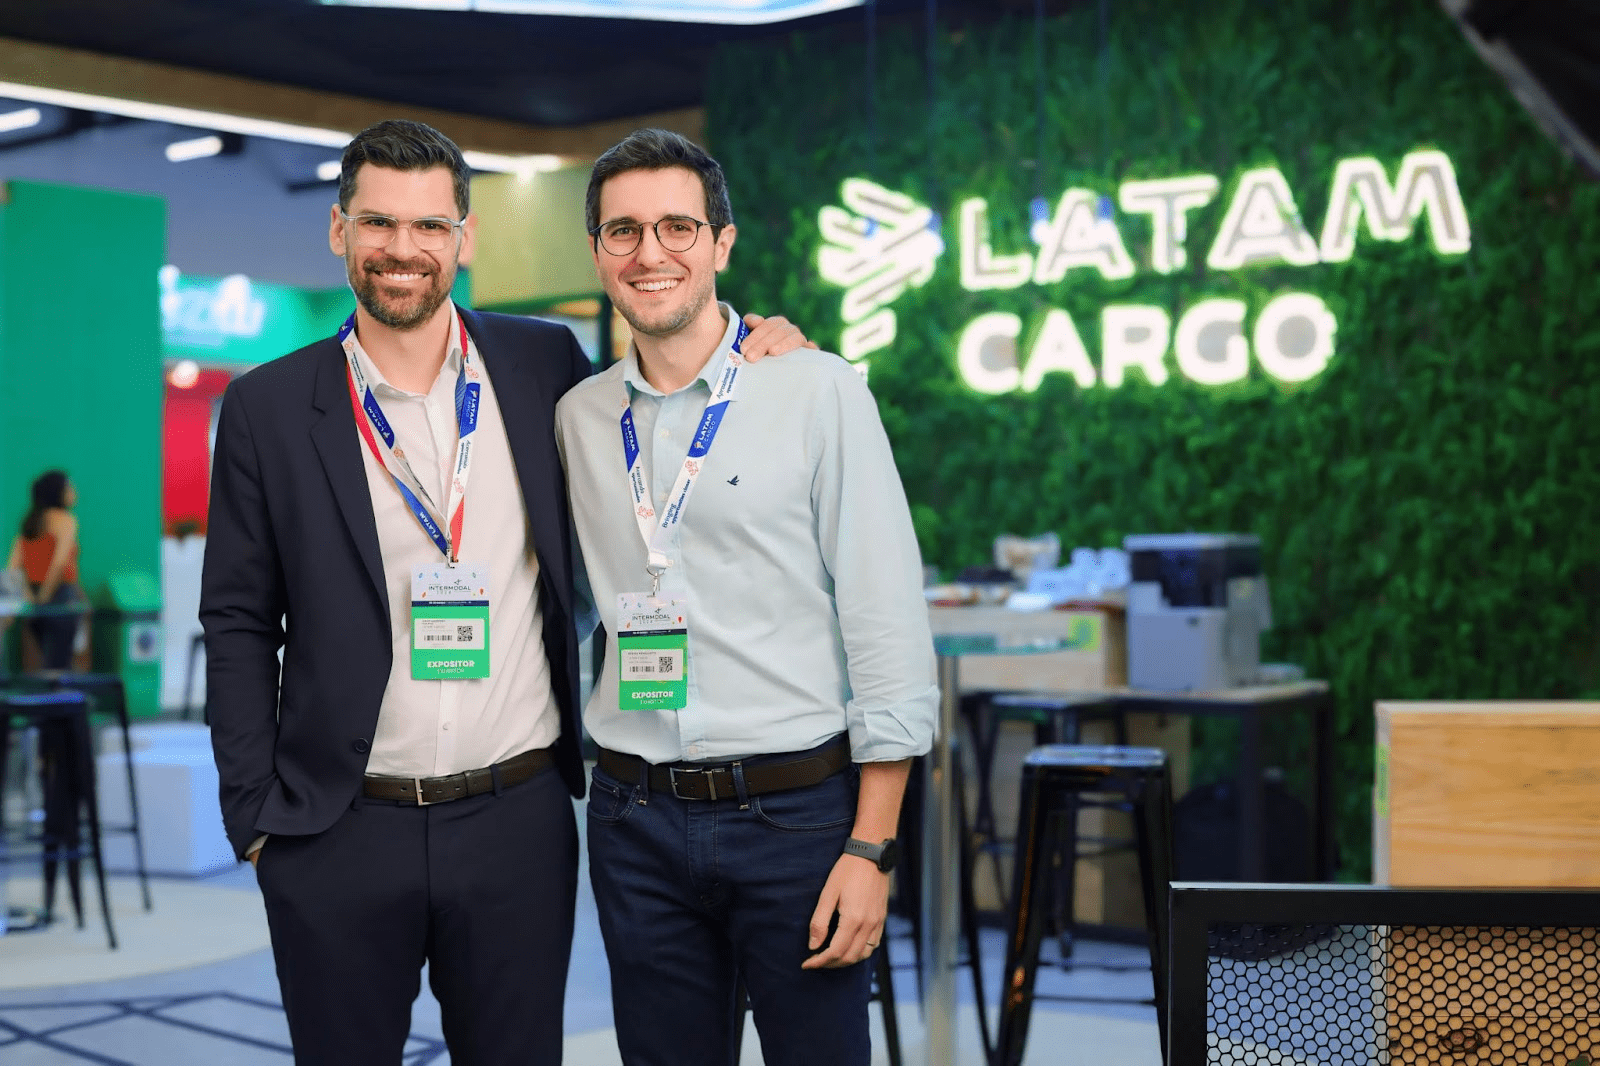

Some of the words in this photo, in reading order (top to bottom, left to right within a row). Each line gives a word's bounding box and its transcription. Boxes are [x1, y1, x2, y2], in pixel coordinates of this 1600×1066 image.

[959, 150, 1470, 290] LATAM
[957, 292, 1337, 394] CARGO
[368, 405, 384, 431] LATAM
[468, 398, 476, 424] LATAM
[626, 425, 636, 451] LATAM
[699, 413, 714, 441] LATAM
[420, 510, 436, 534] LATAM
[662, 502, 676, 528] Bringing
[427, 660, 475, 668] EXPOSITOR
[631, 691, 674, 699] EXPOSITOR
